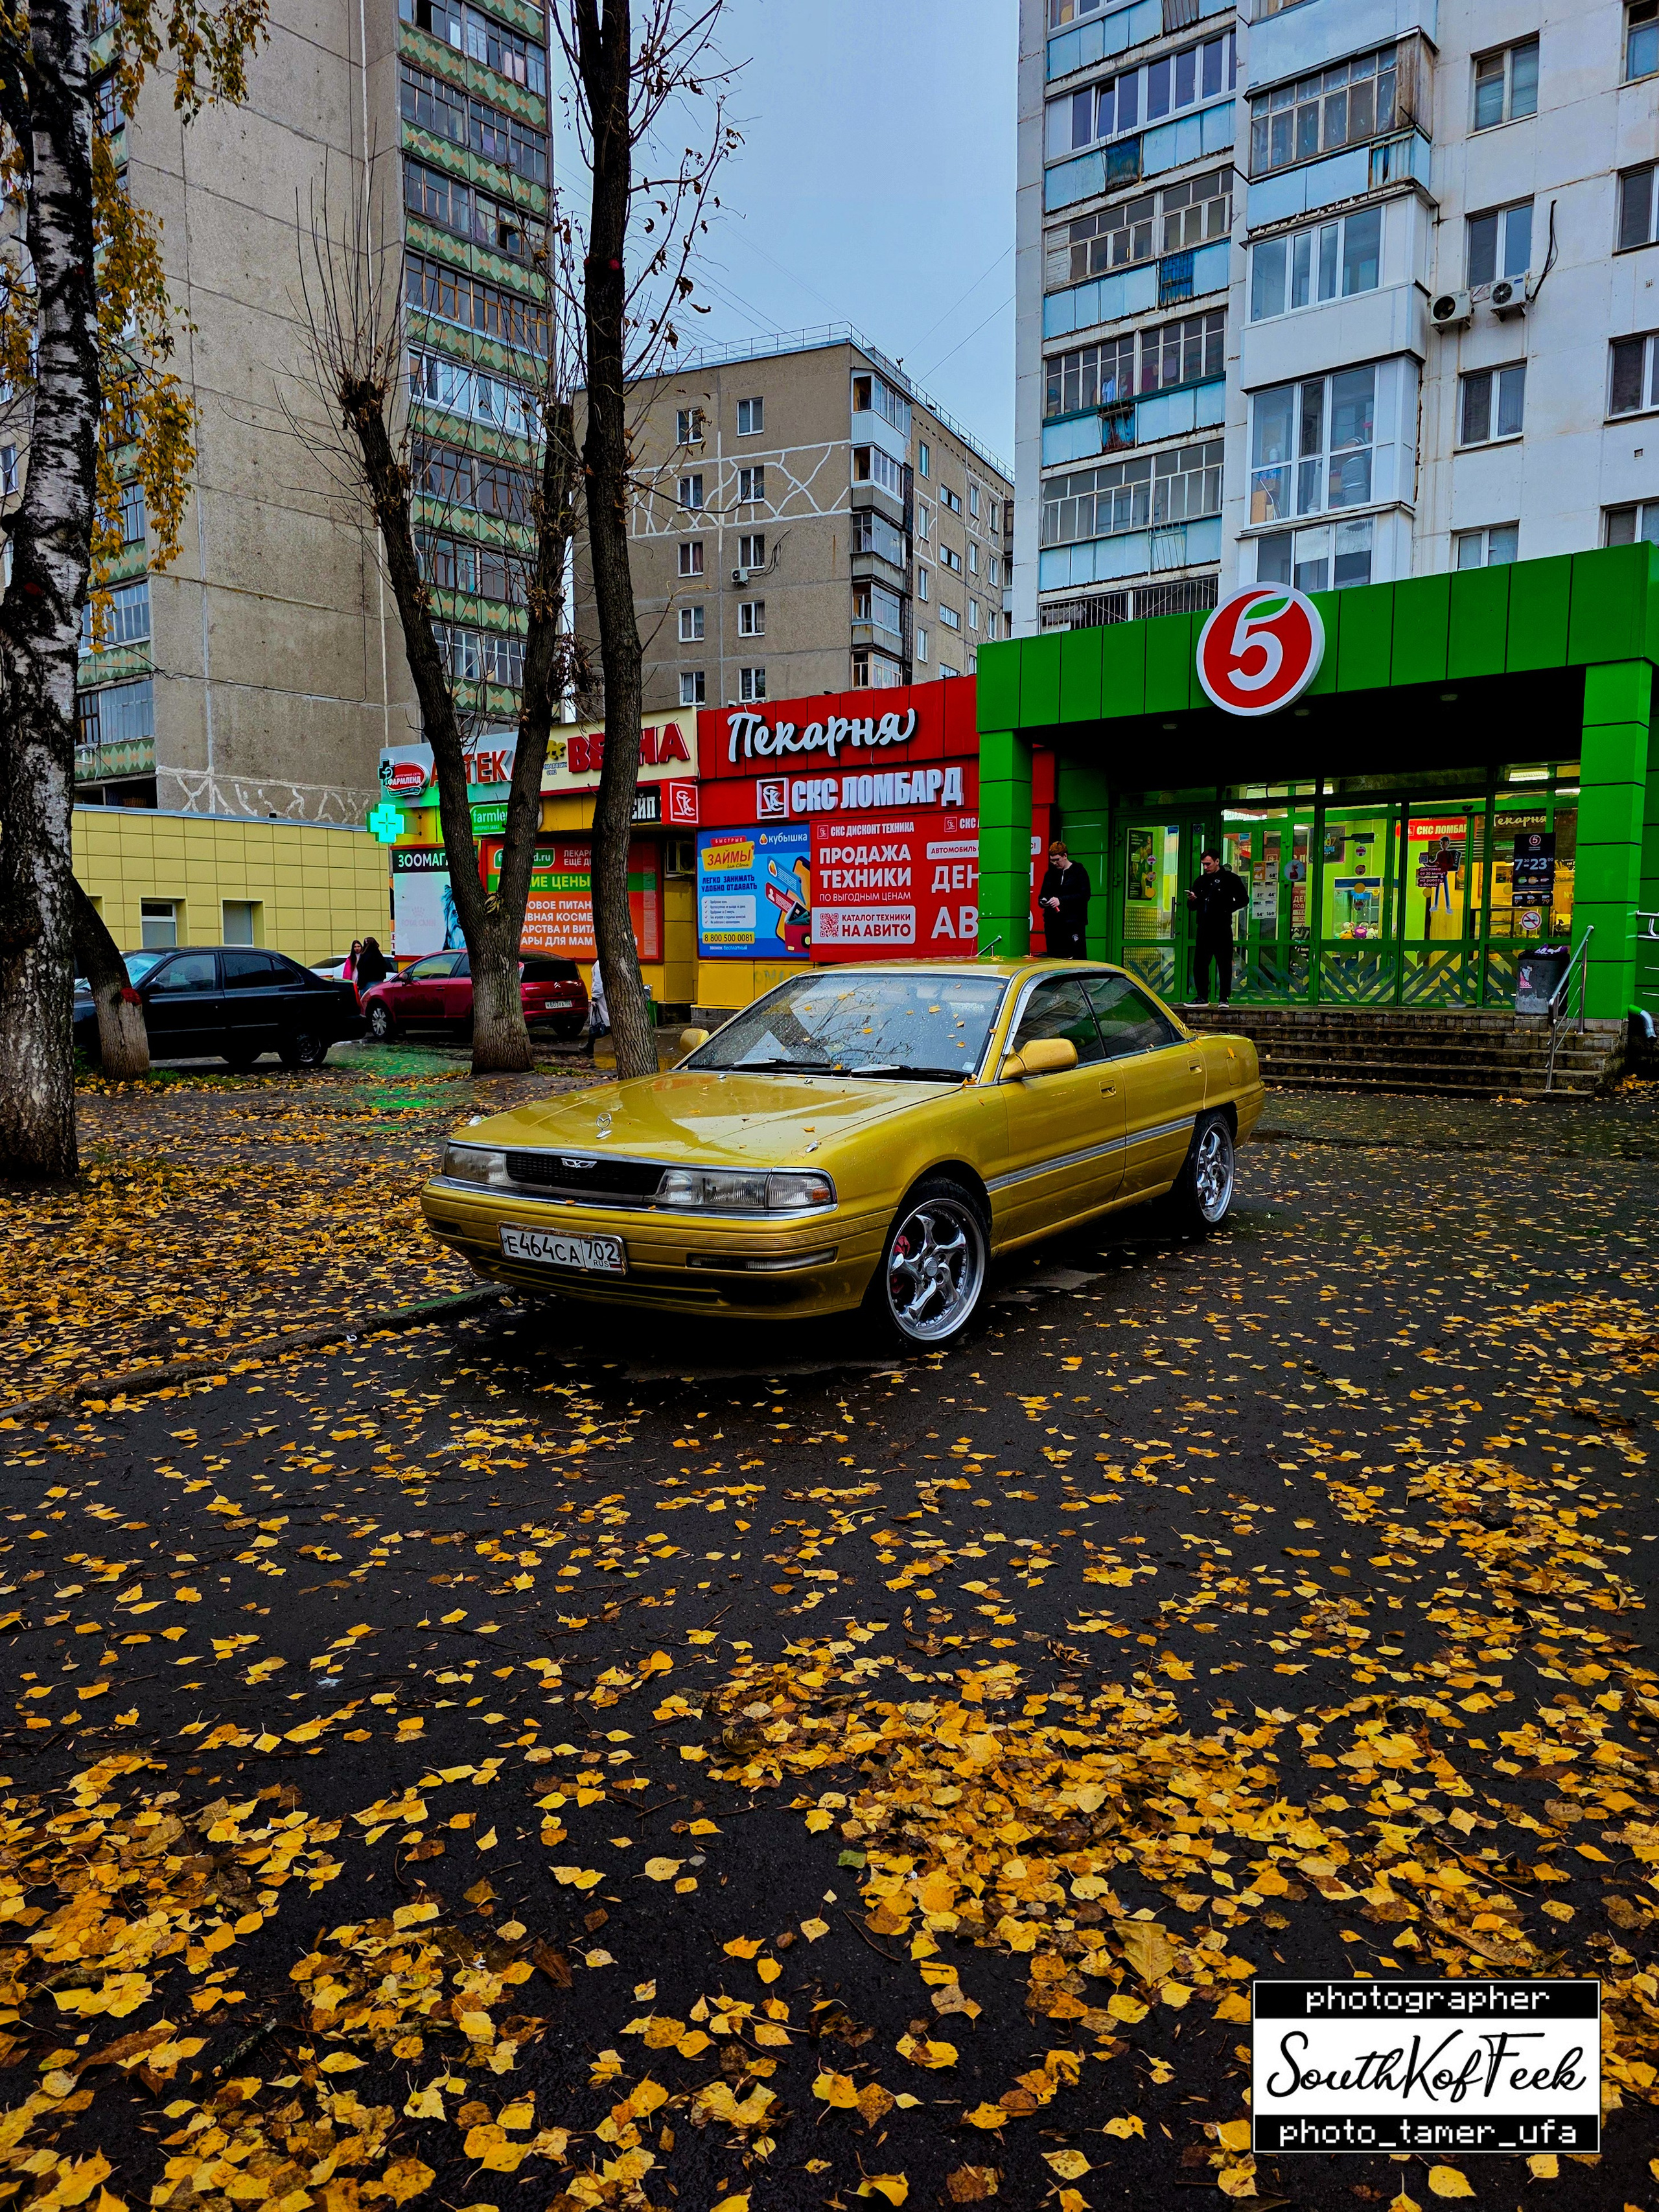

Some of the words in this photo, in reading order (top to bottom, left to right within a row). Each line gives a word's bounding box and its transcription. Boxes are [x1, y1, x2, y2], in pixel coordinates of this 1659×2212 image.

[1227, 590, 1294, 692] 5
[727, 708, 916, 763] Пекарня
[567, 723, 690, 773] ВЕНА
[388, 776, 421, 786] ФАРМЛЕНД
[792, 776, 839, 813] СКС
[841, 767, 964, 808] ЛОМБАРД
[632, 793, 656, 820] ЕЙП
[473, 808, 507, 823] farmle
[830, 825, 846, 837] СКС
[846, 823, 880, 837] ДИСКОНТ
[882, 821, 915, 833] ТЕХНИКА
[959, 817, 976, 829] СКС
[1417, 825, 1433, 835] СКС
[769, 832, 807, 844] кубышка
[707, 849, 751, 866] ЗАЙМЫ
[819, 844, 912, 865] ПРОДАЖА
[931, 846, 977, 855] АВТОМОБИЛЬ
[398, 852, 448, 867] ЗООМАГ
[551, 876, 590, 890] ЦЕНЫ
[723, 874, 755, 883] ЗАНИМАТЬ
[819, 867, 912, 889] ТЕХНИКИ
[931, 865, 979, 893] ДЕН
[726, 883, 758, 891] ОТДАВАТЬ
[819, 893, 831, 902] ПО
[833, 892, 880, 902] ВЫГОДНЫМ
[881, 892, 911, 902] ЦЕНАМ
[526, 900, 556, 909] ОВОЕ
[559, 900, 592, 909] ПИТАН
[556, 913, 593, 921] КОСМЕ
[931, 905, 979, 939] АВ
[522, 924, 561, 933] АРСТВА
[563, 925, 570, 933] И
[842, 924, 862, 937] НА
[863, 924, 911, 937] АВИТО
[520, 937, 542, 946] АРЫ
[545, 937, 566, 947] ДЛЯ
[568, 937, 593, 946] МАМ
[584, 1240, 617, 1261] 702
[593, 1259, 609, 1268] RUS
